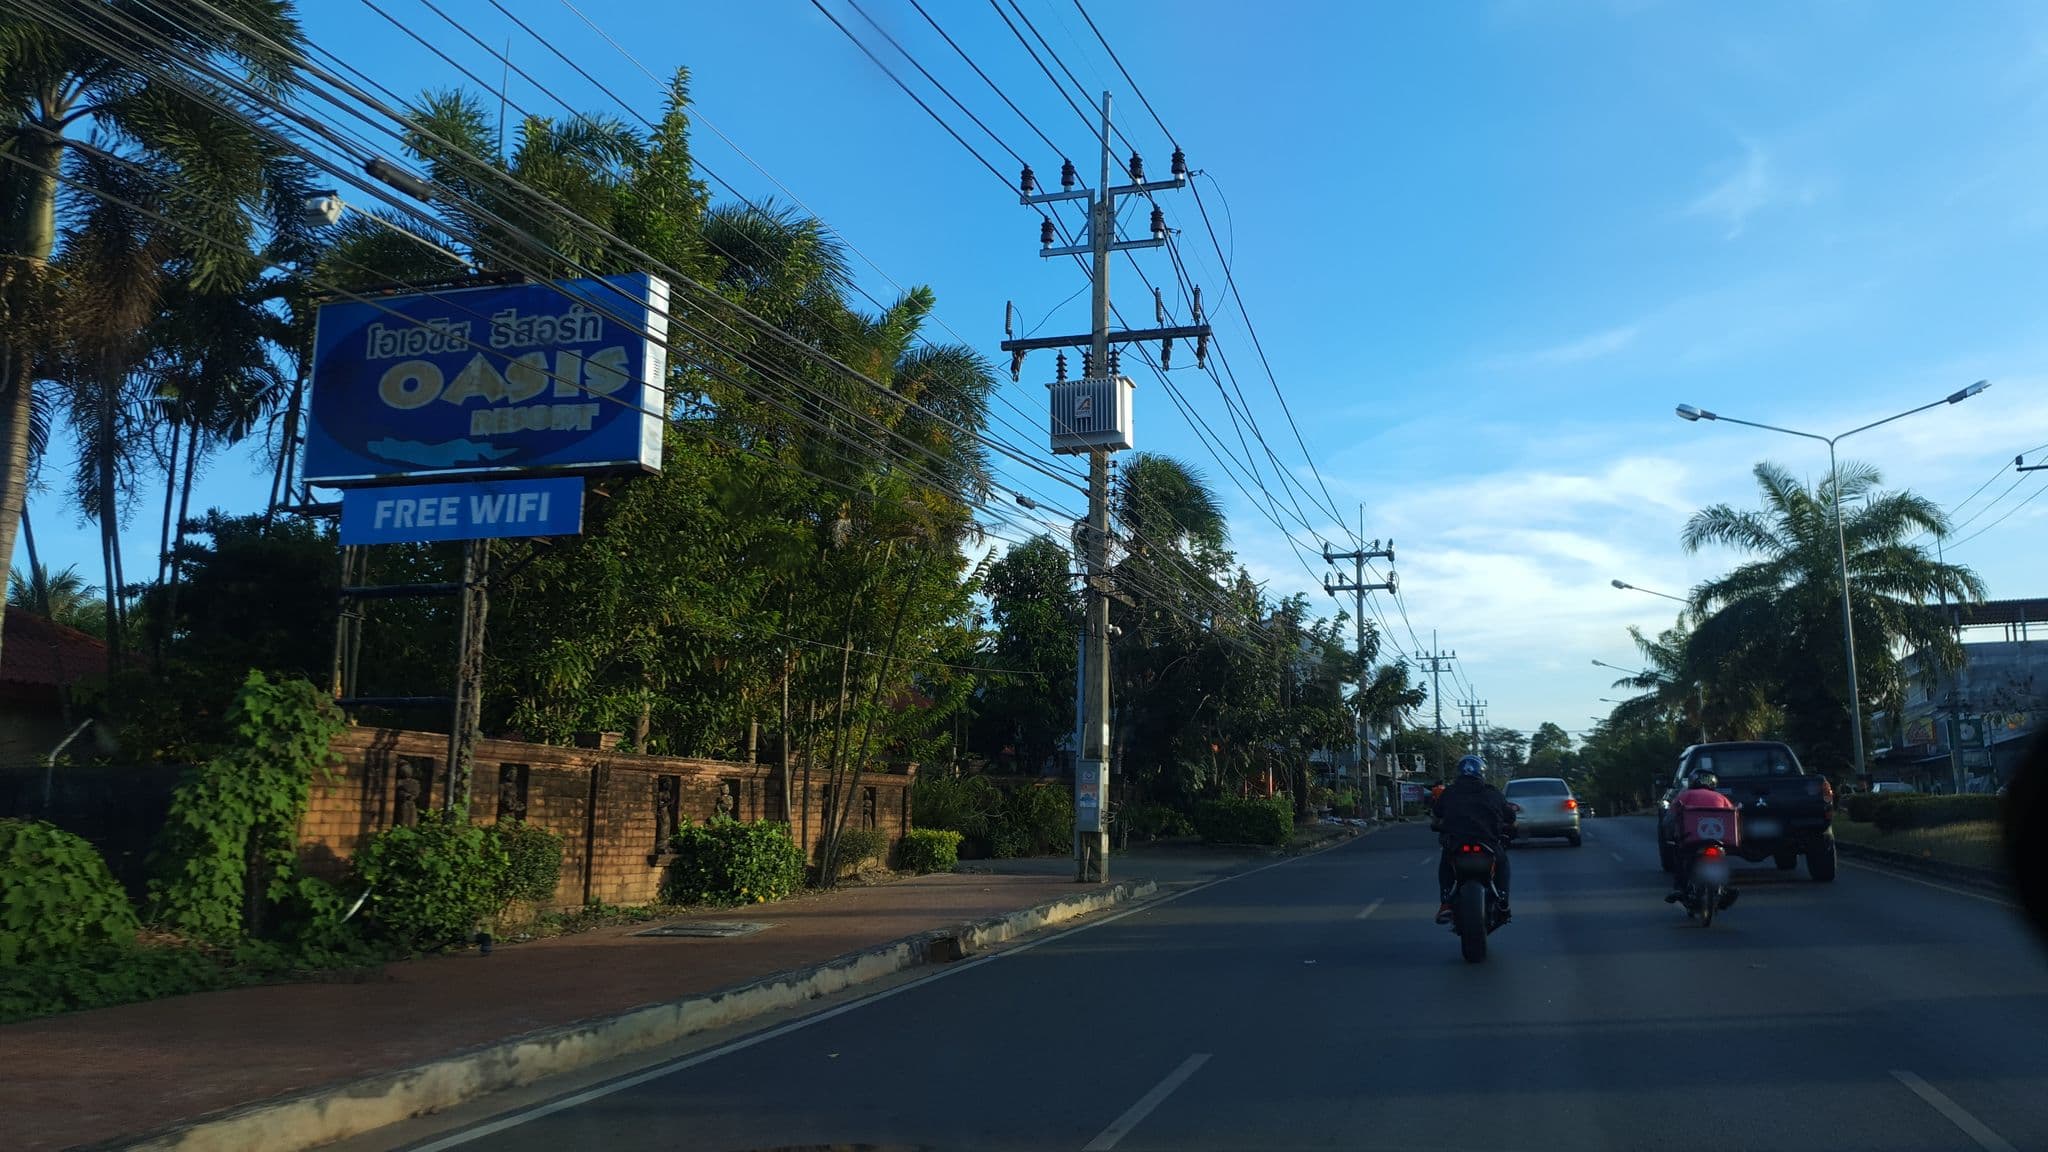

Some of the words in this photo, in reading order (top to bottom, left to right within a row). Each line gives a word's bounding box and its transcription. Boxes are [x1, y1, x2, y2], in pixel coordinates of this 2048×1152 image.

[378, 346, 631, 410] OASIS
[468, 403, 600, 436] RESORT
[373, 496, 462, 529] FREE
[469, 492, 550, 524] WIFI
